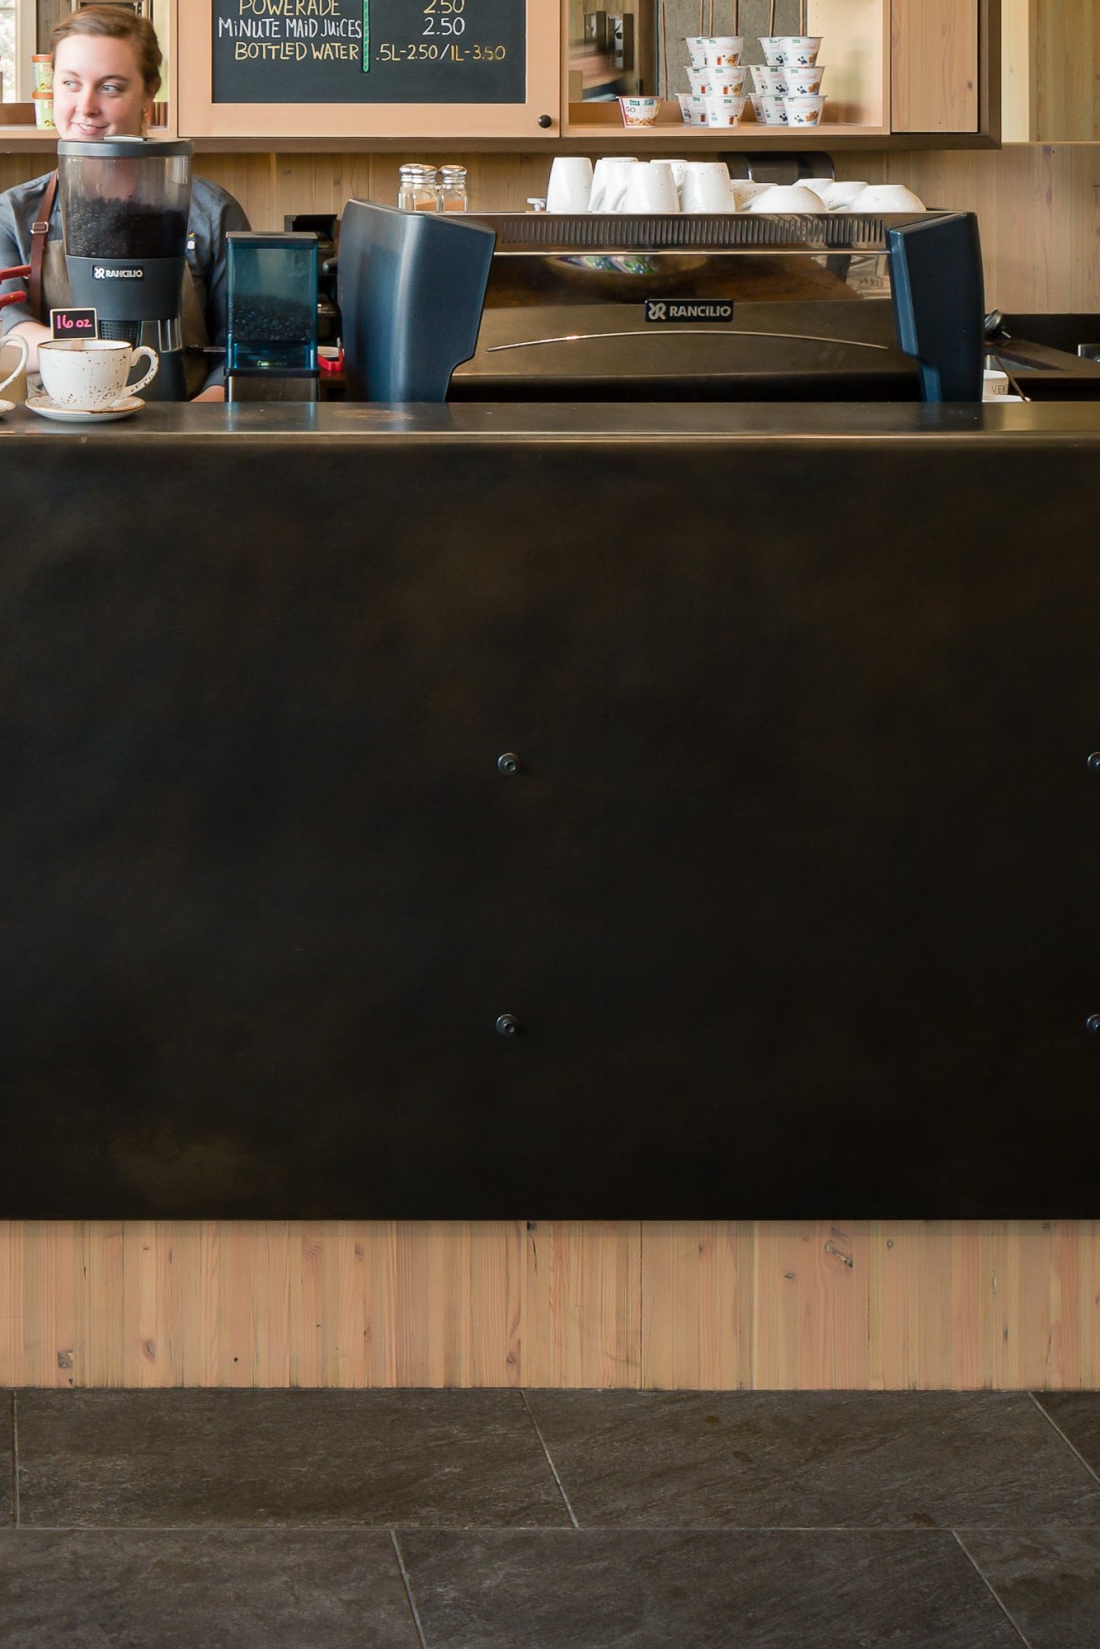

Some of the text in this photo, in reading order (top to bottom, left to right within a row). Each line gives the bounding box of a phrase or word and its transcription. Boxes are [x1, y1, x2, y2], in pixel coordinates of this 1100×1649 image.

[422, 16, 466, 36] 2.50
[234, 41, 307, 62] BOTTLED
[310, 42, 360, 61] WATER
[105, 269, 143, 278] RANCILIO
[669, 305, 732, 317] RANCILIO
[56, 314, 93, 330] 16 oz
